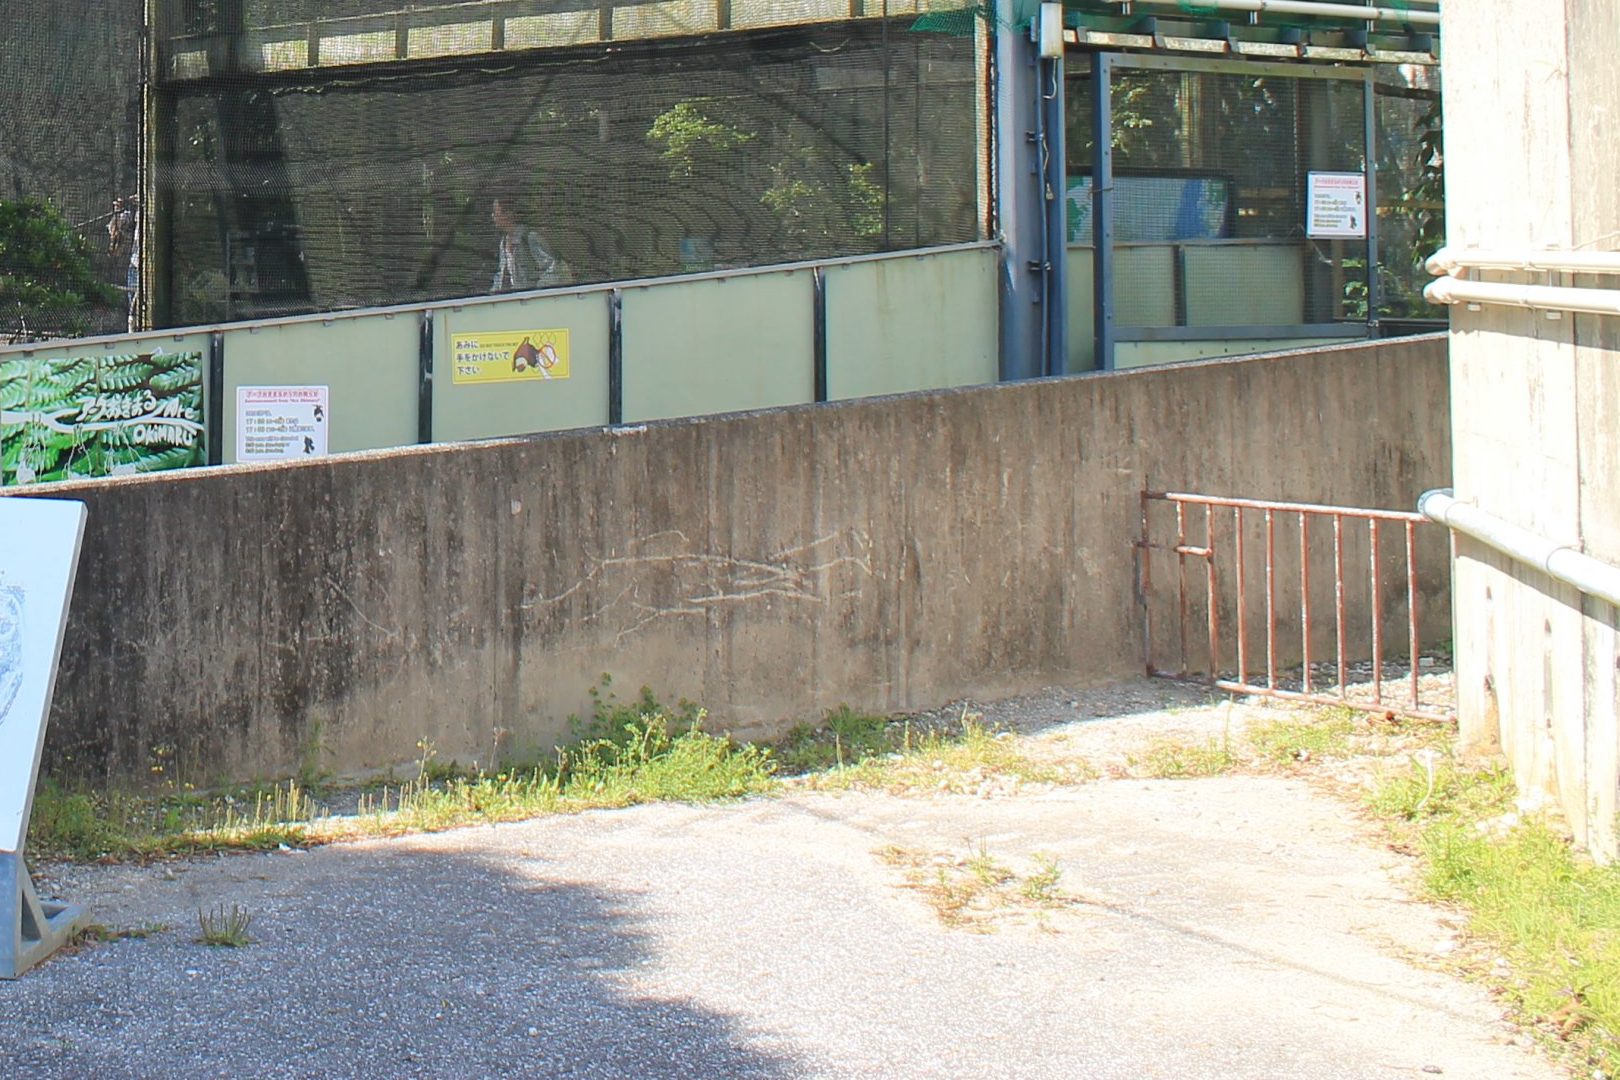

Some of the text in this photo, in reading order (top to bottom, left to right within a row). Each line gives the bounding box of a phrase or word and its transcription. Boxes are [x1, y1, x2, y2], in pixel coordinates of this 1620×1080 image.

[456, 340, 478, 350] あみに
[456, 351, 509, 363] 手をかけないで
[457, 366, 480, 375] 下さい
[75, 389, 157, 422] アークおきまる
